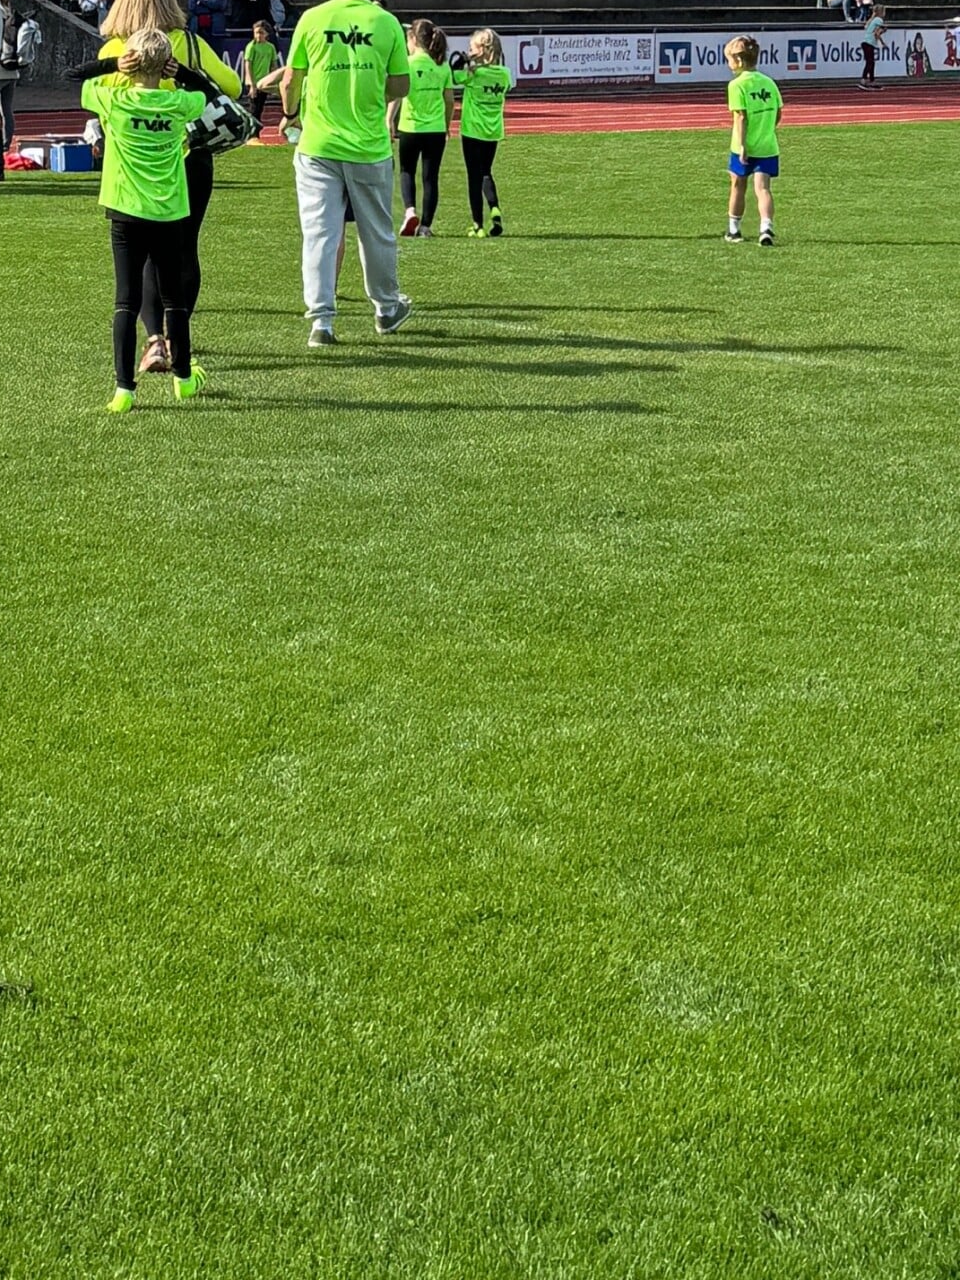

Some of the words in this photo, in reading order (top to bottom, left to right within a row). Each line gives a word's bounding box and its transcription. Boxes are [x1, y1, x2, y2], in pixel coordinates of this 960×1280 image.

[324, 27, 373, 50] TVK
[821, 41, 901, 63] Volksank
[131, 116, 172, 132] TVK
